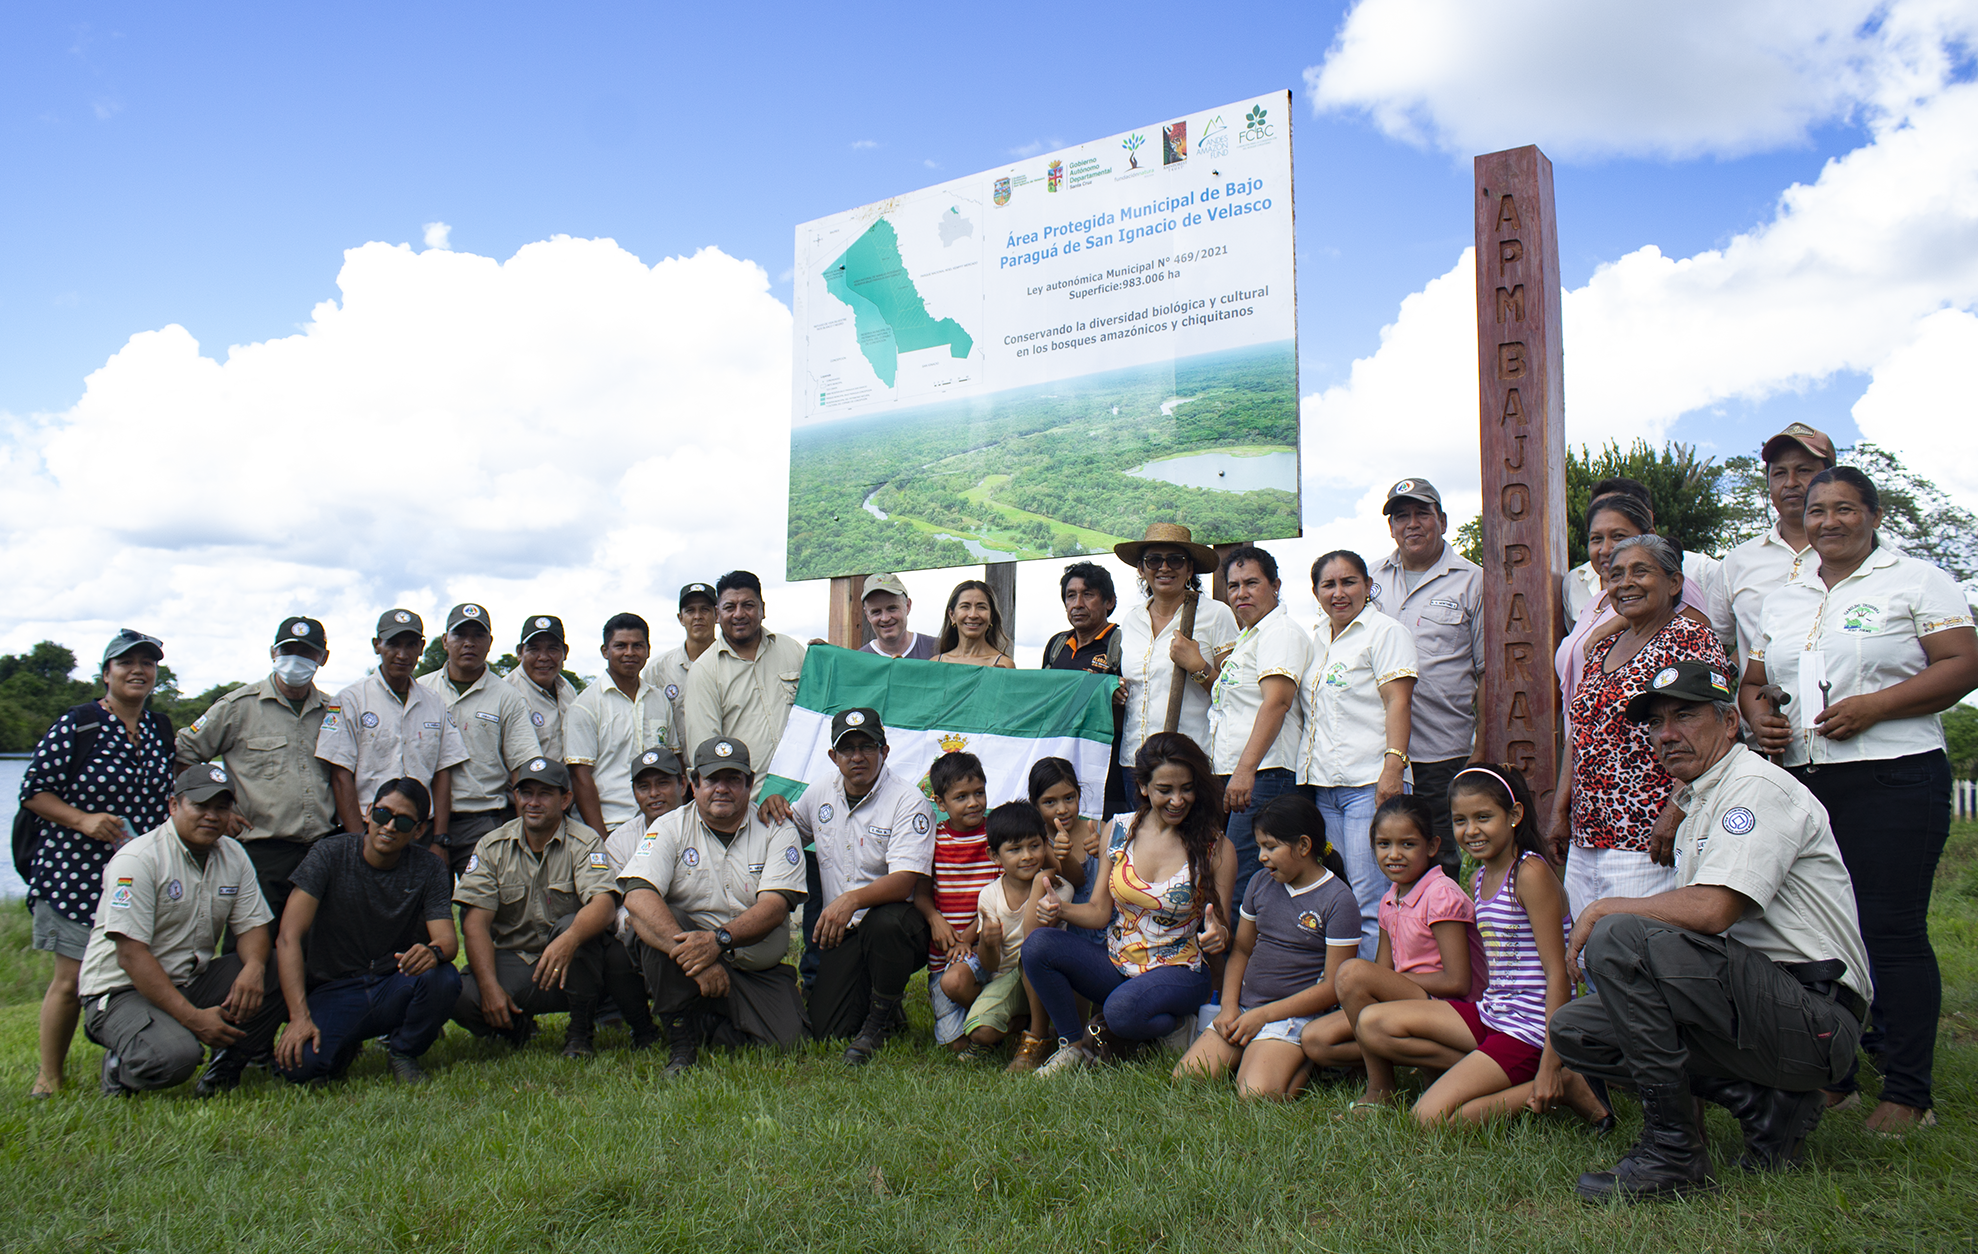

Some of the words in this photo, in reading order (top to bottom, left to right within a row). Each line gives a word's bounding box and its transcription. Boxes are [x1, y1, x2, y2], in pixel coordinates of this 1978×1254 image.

[1196, 142, 1228, 156] AMAZON
[1206, 135, 1228, 146] ANDES
[1239, 125, 1274, 143] FCBC
[1070, 157, 1097, 169] Gobierno
[1070, 164, 1100, 176] Autónomo
[1211, 149, 1228, 159] FUND
[1070, 167, 1112, 183] Departamental
[1006, 231, 1038, 248] Área
[1044, 212, 1114, 239] Protegida
[1121, 191, 1194, 221] Municipal
[1200, 187, 1220, 202] de
[1226, 178, 1263, 196] Bajo
[1001, 242, 1058, 269] Paraguá
[1063, 240, 1080, 254] de
[1086, 234, 1113, 249] San
[1118, 219, 1177, 243] Ignacio
[1182, 212, 1202, 227] de
[1207, 198, 1272, 221] Velasco
[1028, 286, 1043, 295] Ley
[1046, 273, 1103, 290] autonómica
[1107, 260, 1154, 279] Municipal
[1158, 257, 1170, 268] N°
[1174, 245, 1228, 263] 469/2021
[1495, 194, 1526, 324] APM
[1068, 271, 1164, 299] Superficie:983.006
[1168, 270, 1180, 279] ha
[1004, 324, 1073, 345] Conservando
[1076, 321, 1086, 331] la
[1089, 308, 1148, 329] diversidad
[1152, 299, 1205, 317] biológica
[1210, 298, 1216, 308] y
[1220, 285, 1268, 304] cultural
[1017, 348, 1029, 357] en
[1033, 344, 1048, 354] los
[1052, 336, 1096, 350] bosques
[1100, 322, 1167, 342] amazónicos
[1171, 320, 1178, 331] y
[1181, 306, 1253, 327] chiquitanos
[1498, 341, 1531, 522] BAJO
[1504, 543, 1536, 800] PARAG
